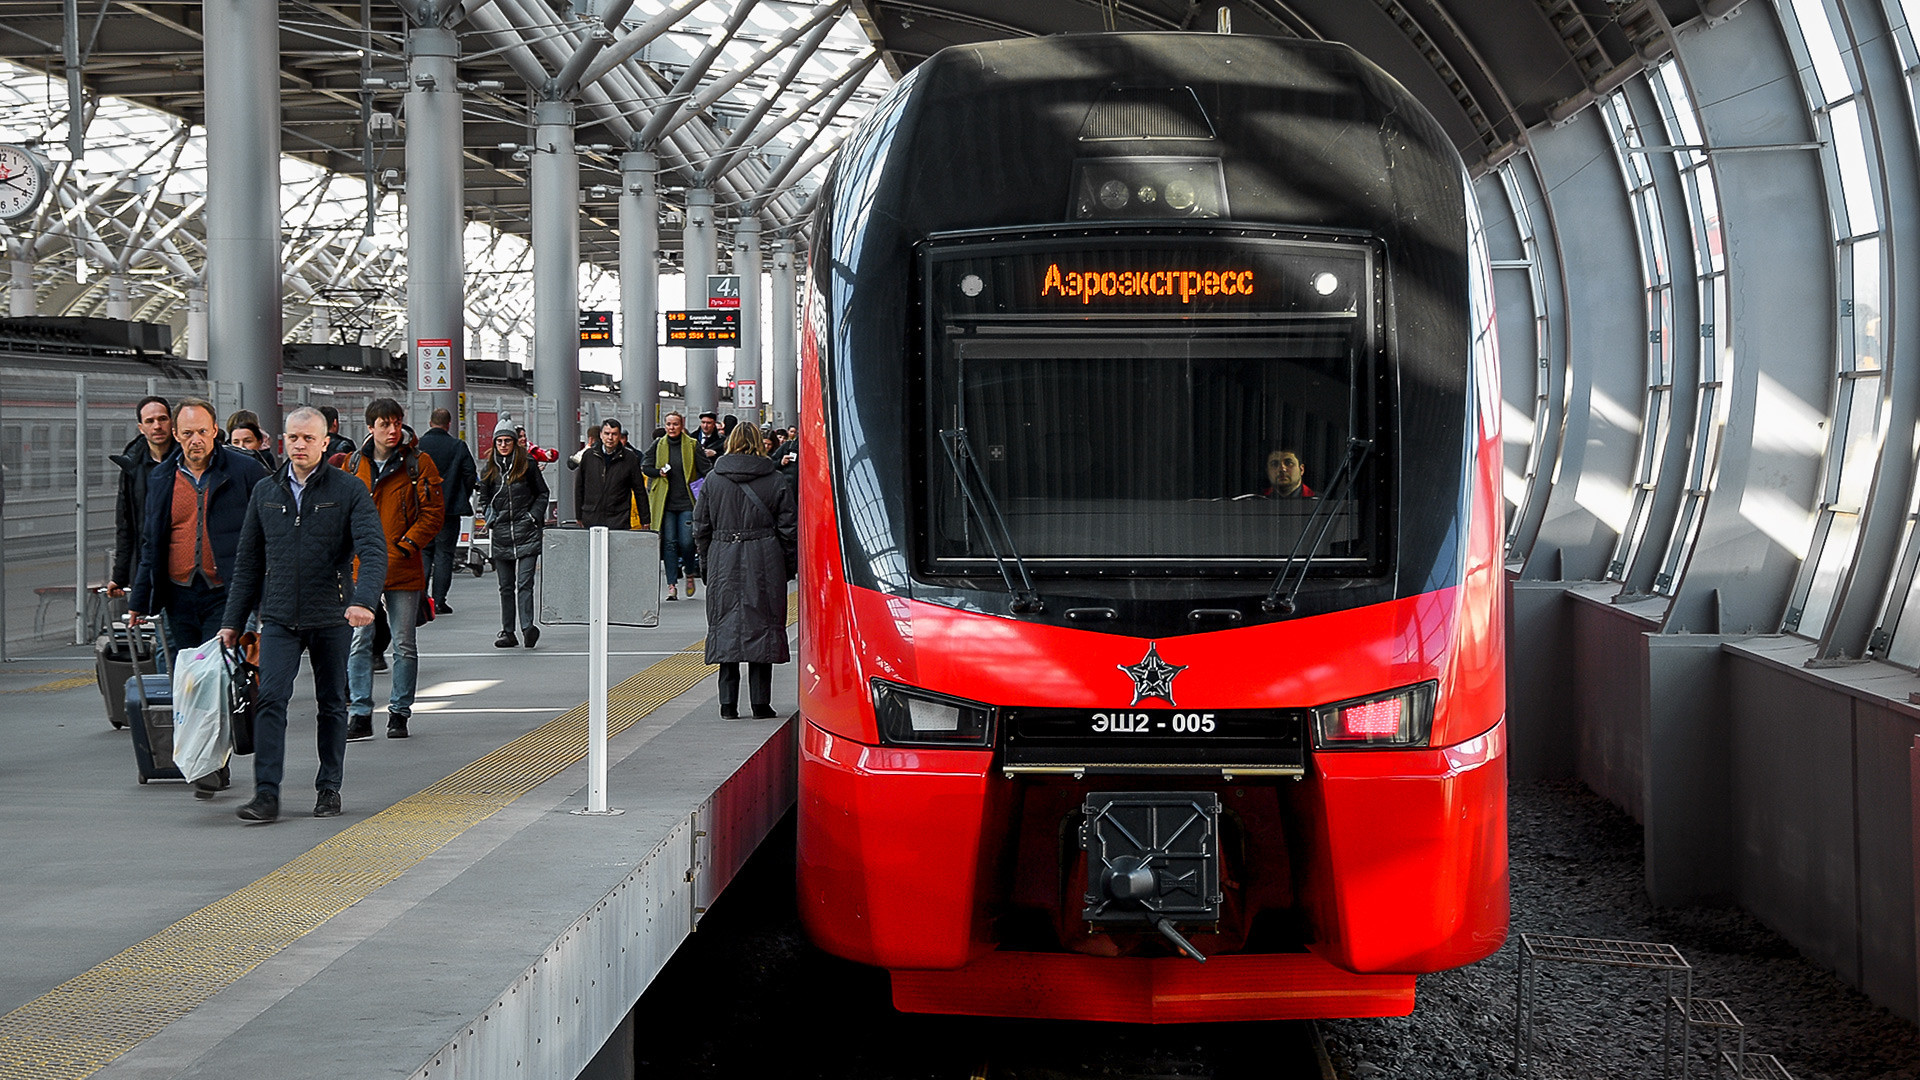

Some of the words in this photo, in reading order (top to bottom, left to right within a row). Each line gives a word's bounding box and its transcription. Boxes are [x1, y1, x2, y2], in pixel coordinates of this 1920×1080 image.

[13, 157, 17, 165] 1
[23, 166, 28, 175] 2
[26, 178, 32, 186] 3
[0, 200, 6, 209] 6
[13, 197, 19, 206] 5
[1041, 263, 1254, 304] Аэроэкспресс
[603, 332, 609, 340] 4
[730, 332, 736, 340] 4
[1091, 713, 1150, 732] ЭШ2
[1172, 713, 1216, 732] 005
